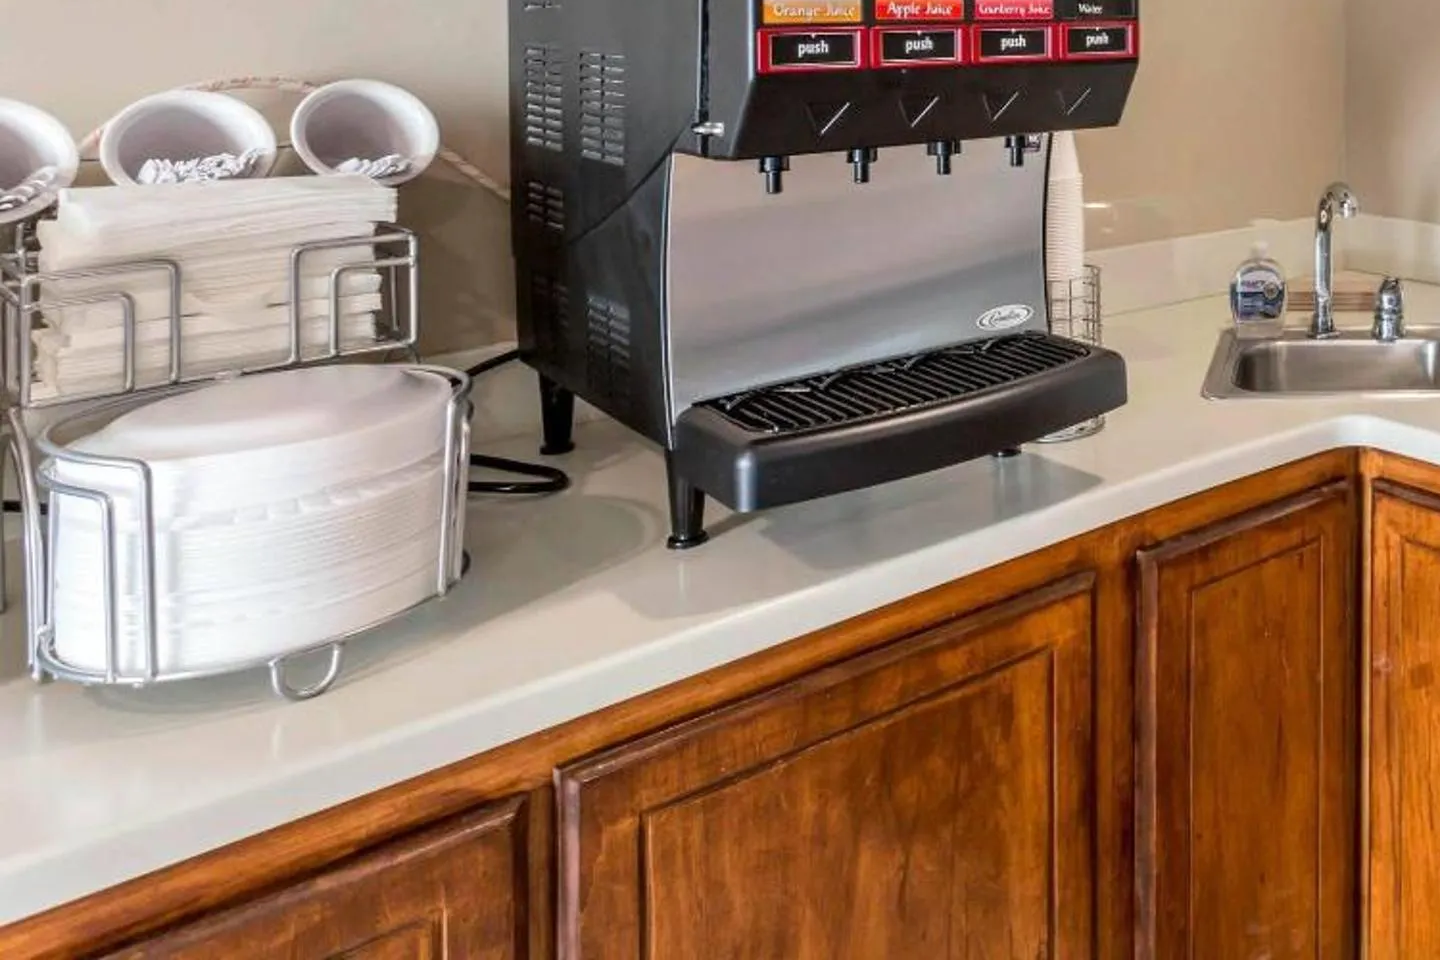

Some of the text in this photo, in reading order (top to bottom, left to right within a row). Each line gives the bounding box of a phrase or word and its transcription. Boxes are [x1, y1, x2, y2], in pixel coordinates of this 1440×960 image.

[772, 3, 855, 22] Orange Juice
[886, 2, 954, 18] Apple Juice
[905, 36, 934, 54] push
[1001, 33, 1026, 51] push
[1085, 31, 1109, 48] push
[798, 40, 829, 58] push
